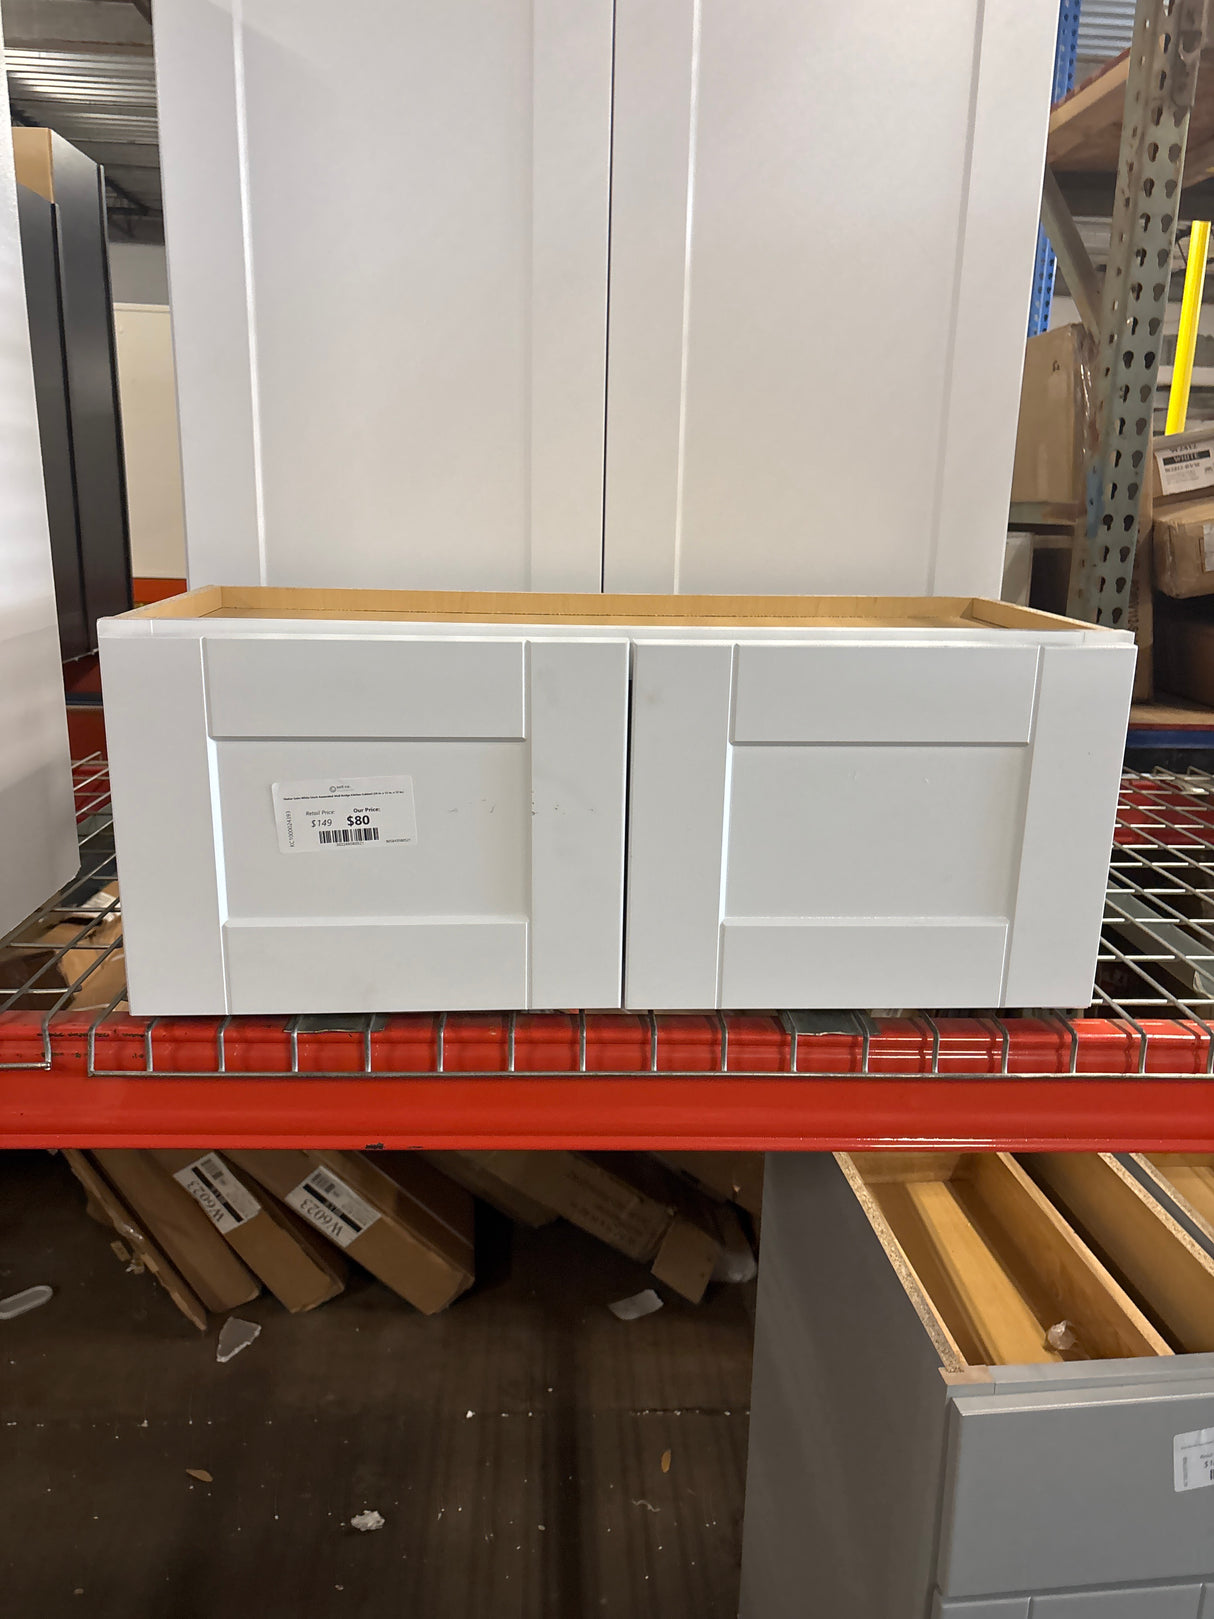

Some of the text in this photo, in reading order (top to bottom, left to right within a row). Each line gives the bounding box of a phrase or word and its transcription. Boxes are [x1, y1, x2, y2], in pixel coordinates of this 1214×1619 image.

[311, 819, 333, 828] $149
[346, 815, 370, 827] $80
[187, 1180, 225, 1223] W6023
[300, 1198, 344, 1238] W6023
